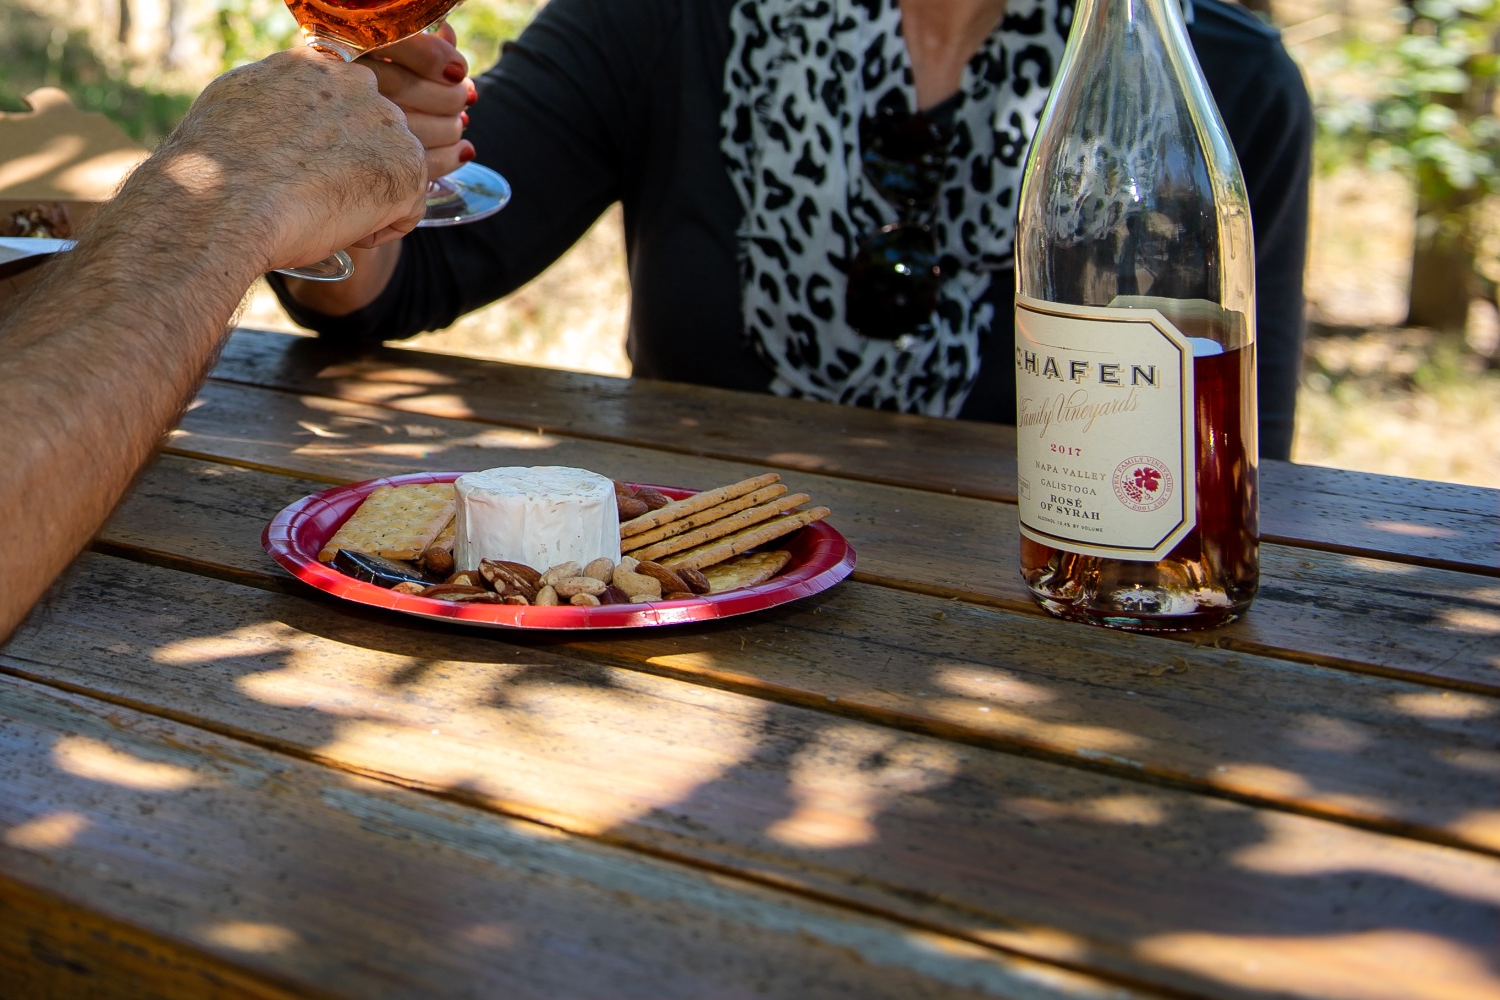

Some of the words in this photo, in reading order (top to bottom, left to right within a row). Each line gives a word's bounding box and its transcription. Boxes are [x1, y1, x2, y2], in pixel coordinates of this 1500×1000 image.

[1018, 395, 1052, 439] Family
[1054, 386, 1140, 433] Vineyards
[1050, 443, 1082, 457] 2017
[1035, 460, 1059, 474] NAPA
[1062, 467, 1106, 481] VALLEY
[1117, 457, 1144, 473] FAMILY
[1040, 478, 1097, 496] CALISTOGA
[1050, 494, 1083, 508] ROSÉ
[1040, 501, 1054, 511] OF
[1056, 505, 1101, 521] SYRAH
[1081, 524, 1104, 533] VOLUME
